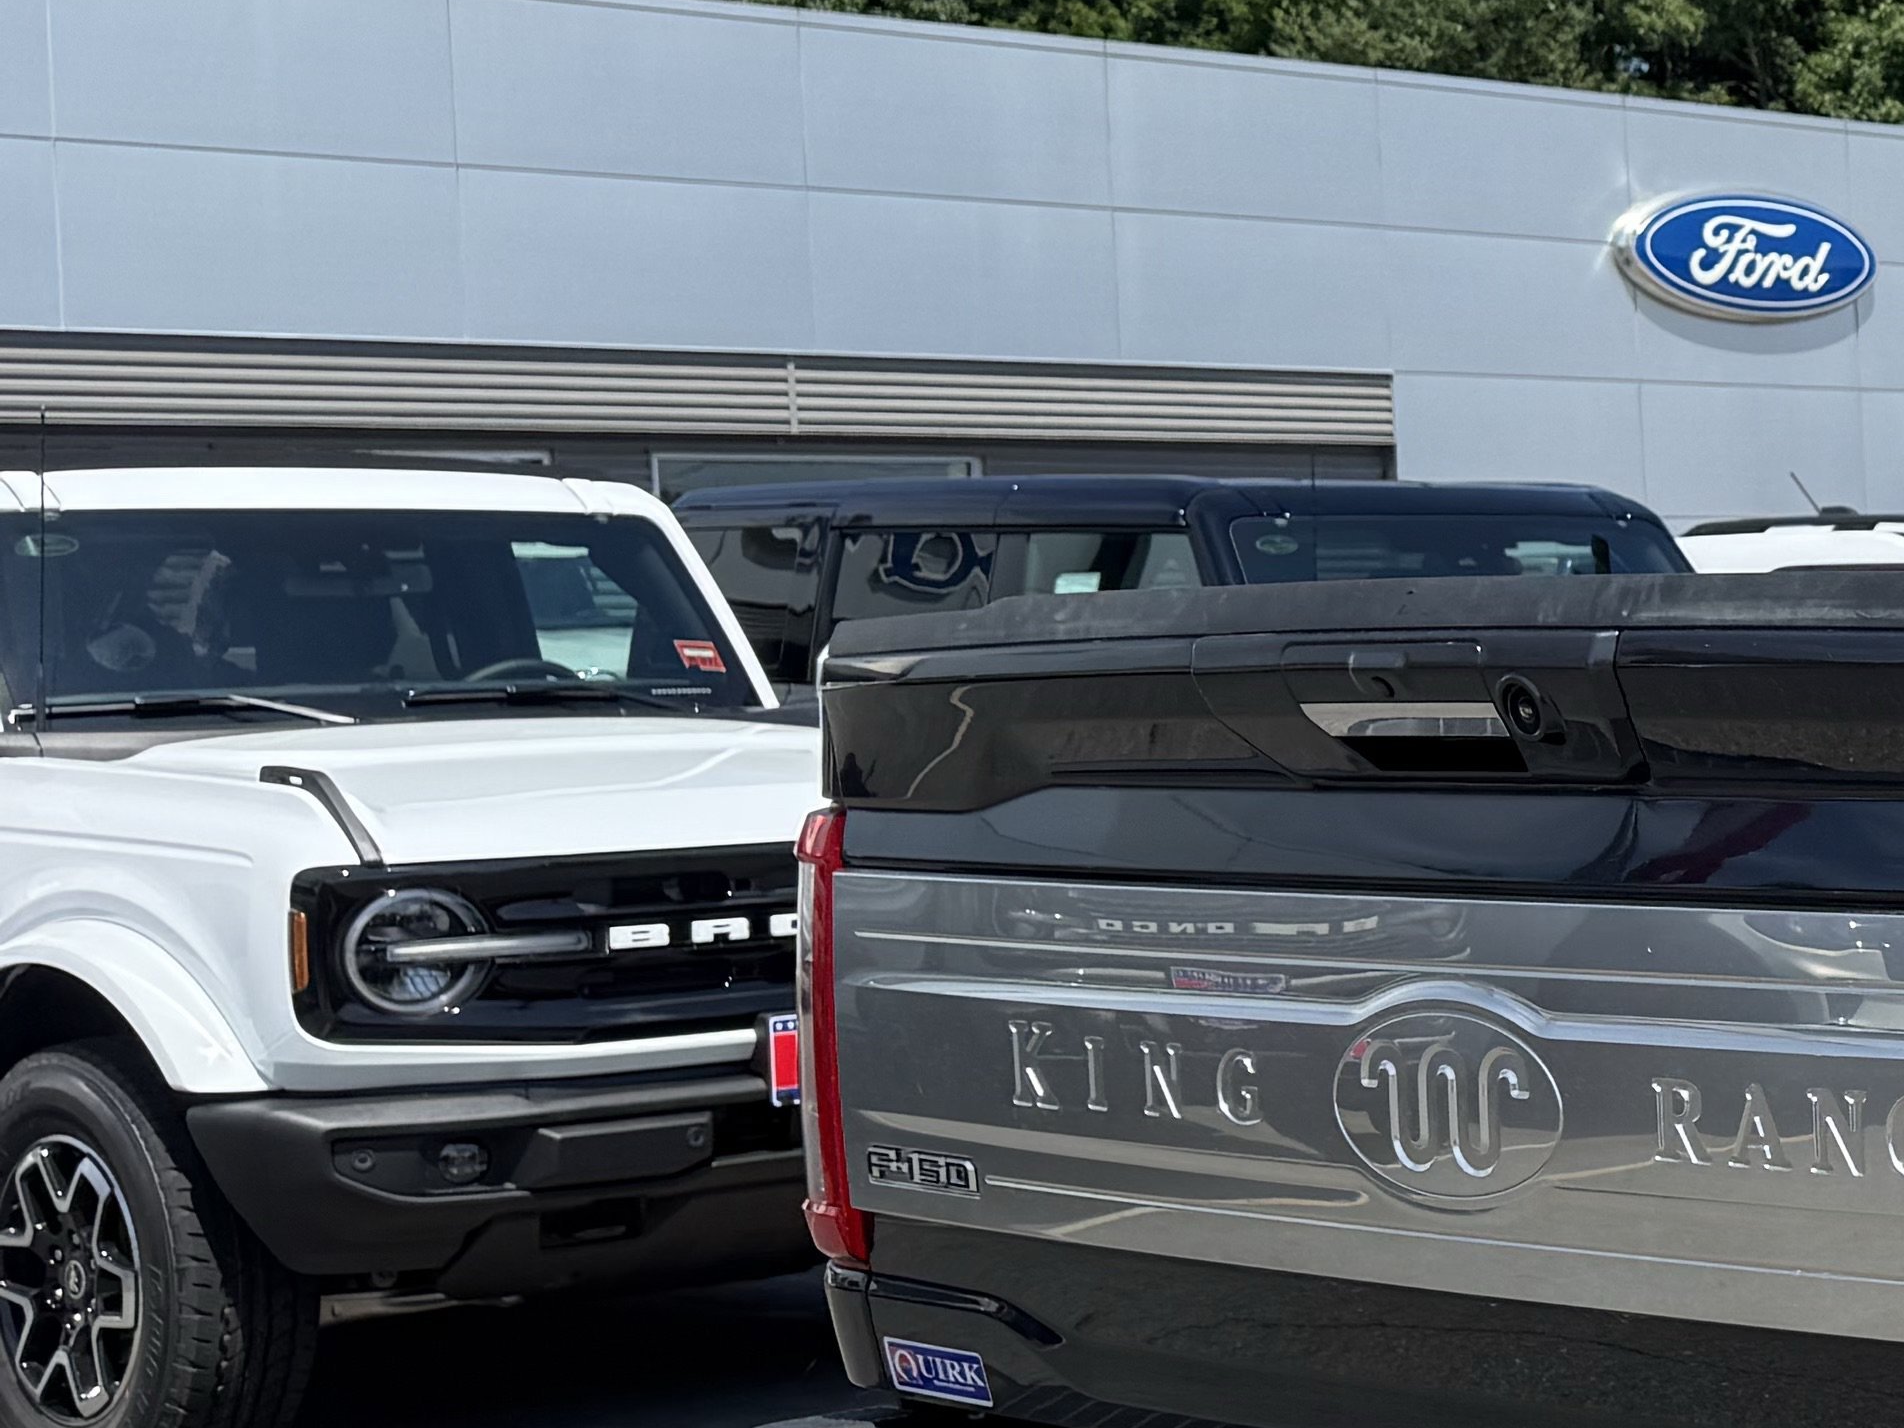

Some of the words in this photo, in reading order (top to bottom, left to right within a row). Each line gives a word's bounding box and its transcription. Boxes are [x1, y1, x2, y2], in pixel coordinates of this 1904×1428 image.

[1688, 214, 1832, 293] Ford
[1008, 1019, 1264, 1125] KING
[867, 1145, 980, 1194] F-150
[894, 1349, 986, 1388] QUIRK
